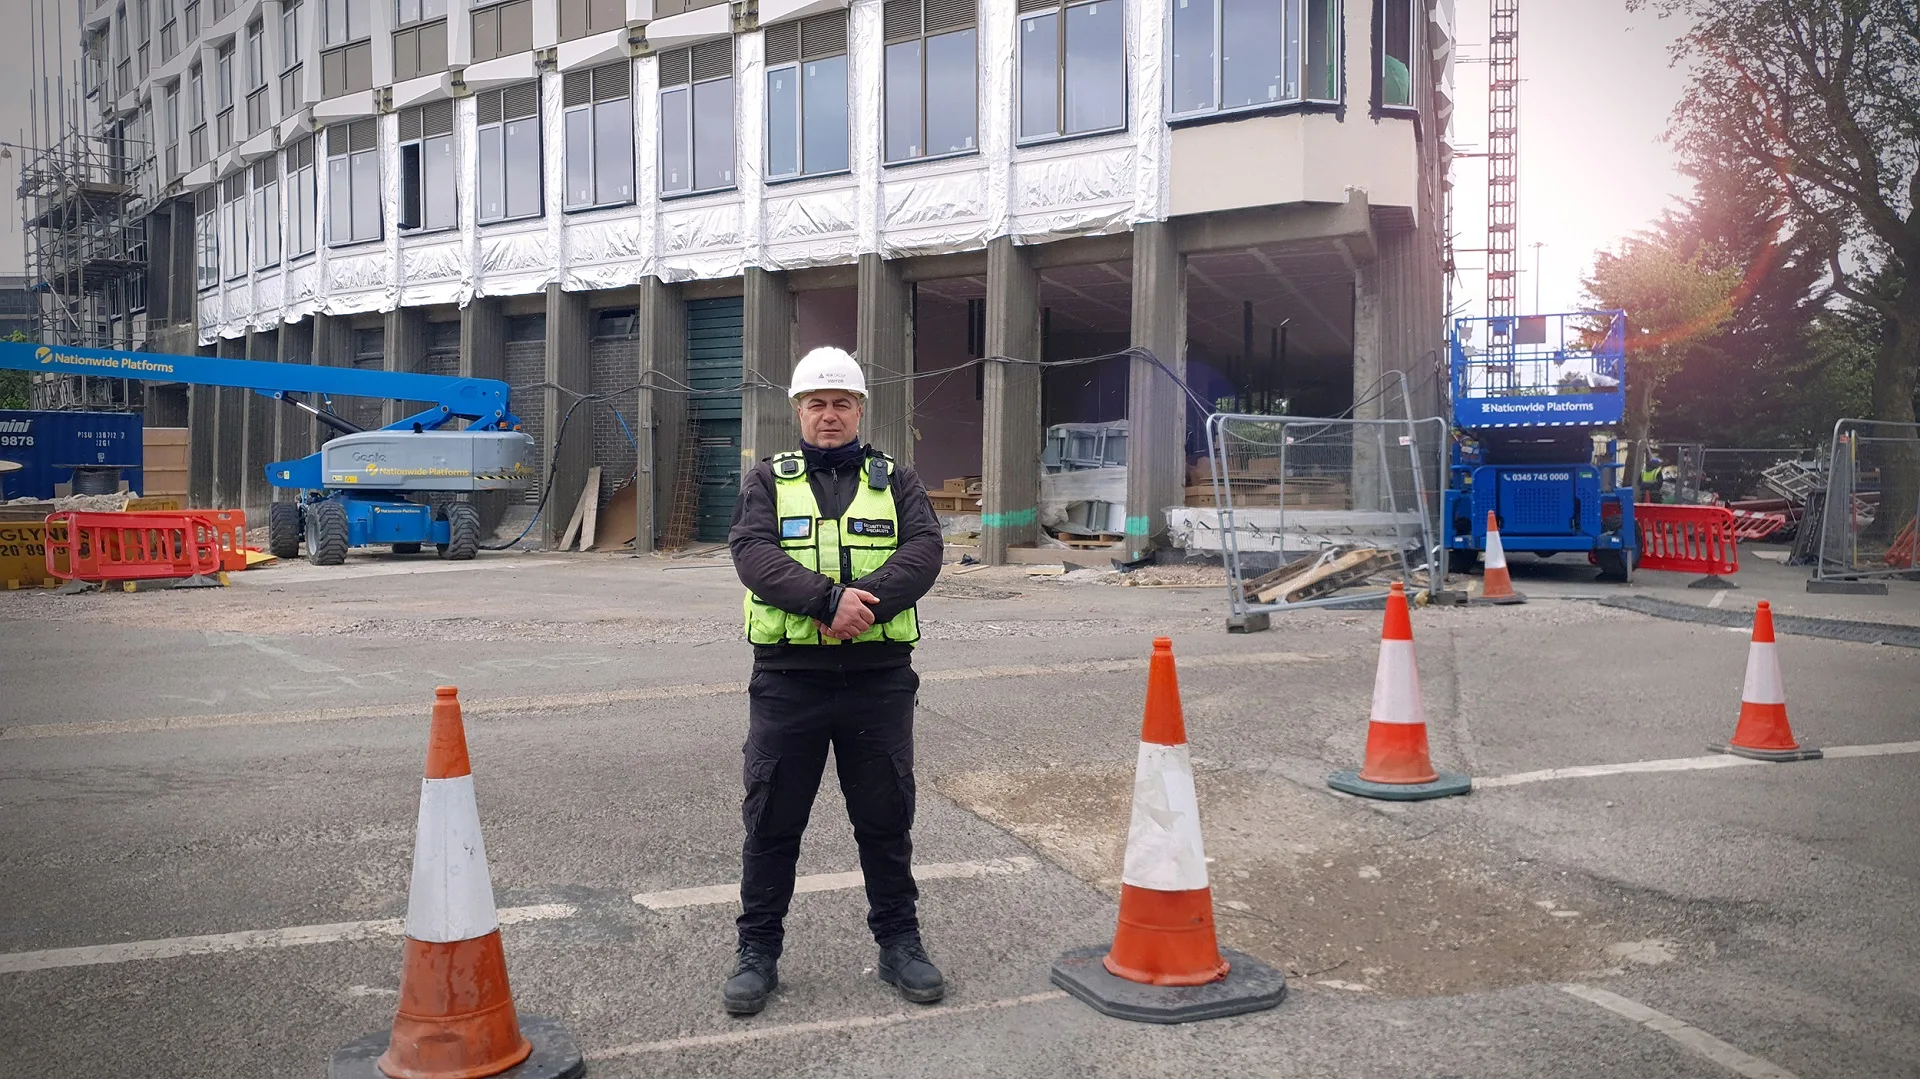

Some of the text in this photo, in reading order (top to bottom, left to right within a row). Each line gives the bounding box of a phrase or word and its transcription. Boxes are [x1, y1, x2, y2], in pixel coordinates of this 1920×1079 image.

[55, 353, 174, 373] Nationwide Platforms
[1490, 402, 1594, 412] Nationwide Platforms
[0, 436, 34, 446] 9878
[379, 467, 470, 477] Nationwide Platforms
[1512, 473, 1531, 481] 0345
[1533, 473, 1548, 481] 745
